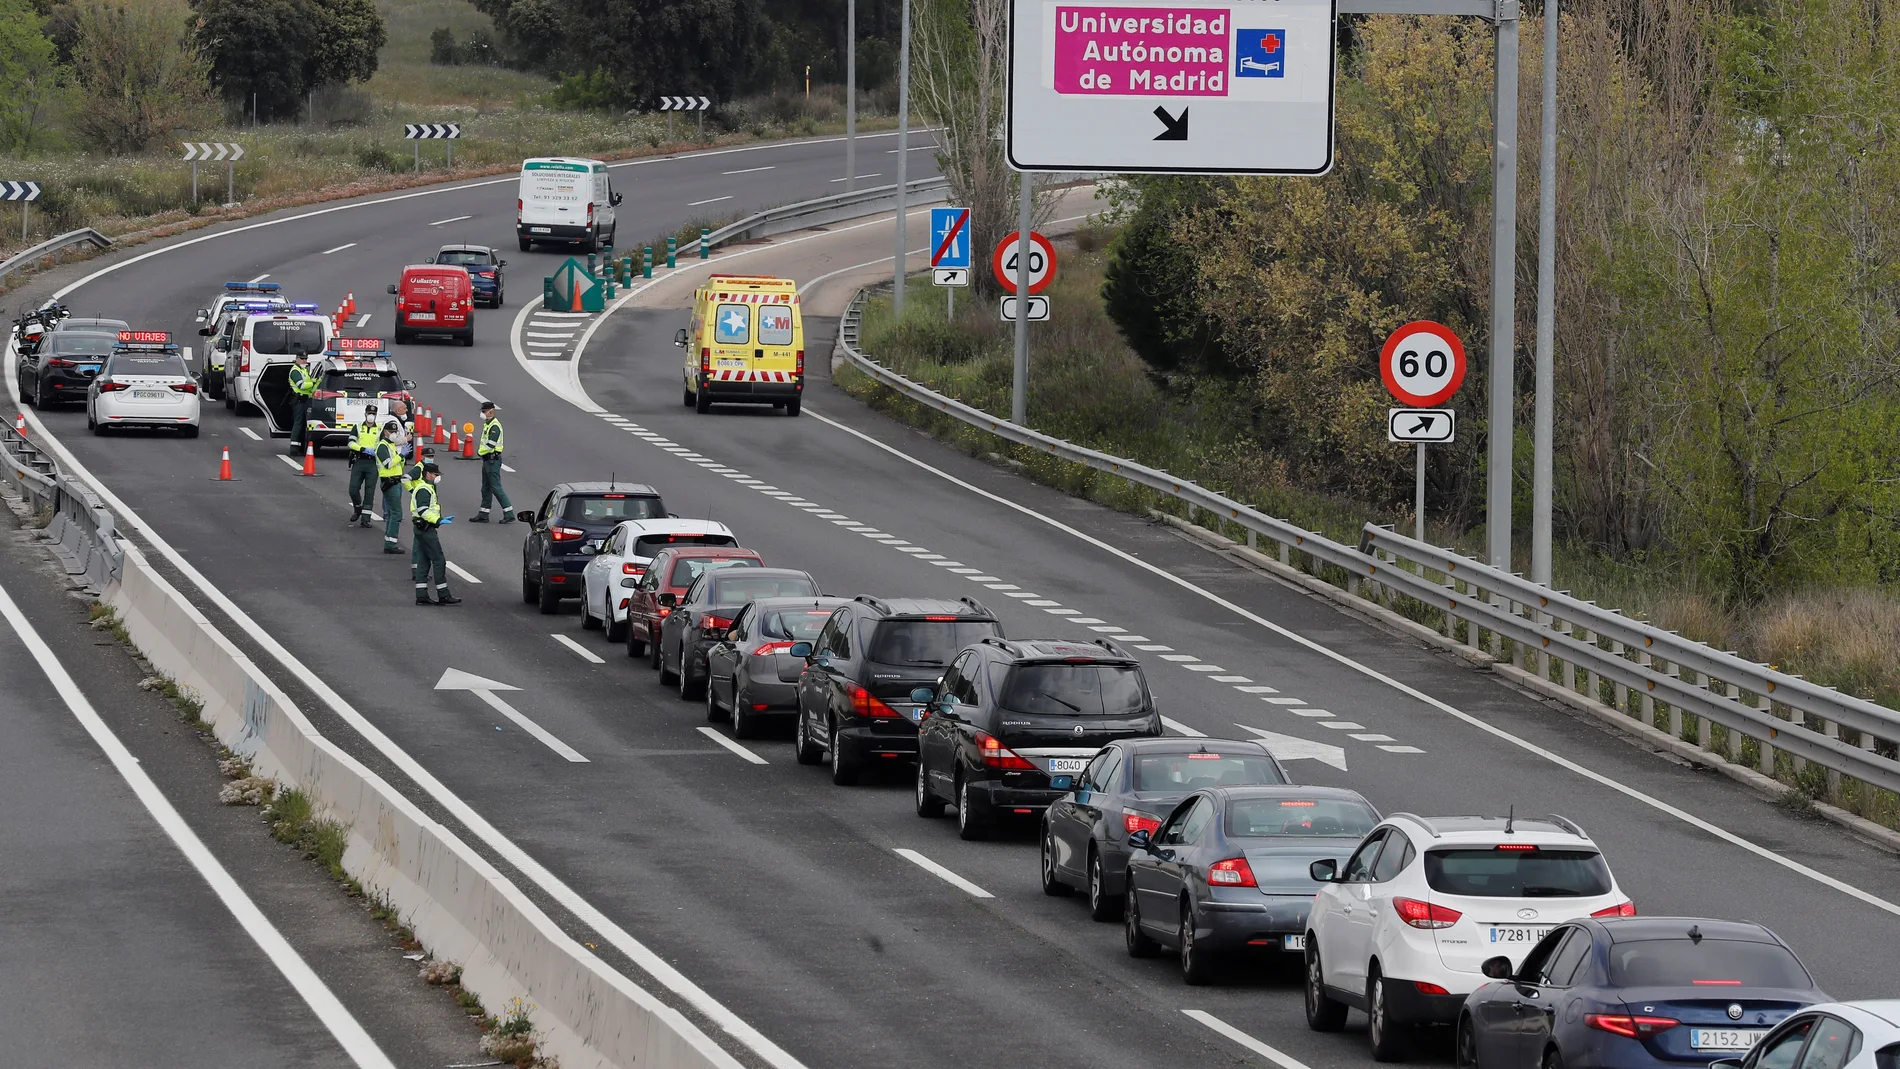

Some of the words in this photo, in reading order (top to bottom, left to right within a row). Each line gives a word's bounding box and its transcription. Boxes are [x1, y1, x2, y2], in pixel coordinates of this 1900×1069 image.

[1060, 12, 1225, 35] Universidad
[1083, 40, 1223, 63] Autónoma
[1079, 69, 1112, 89] de
[1130, 70, 1224, 91] Madrid
[1005, 252, 1044, 274] 40
[119, 332, 131, 340] NO
[134, 332, 166, 341] VIAJES
[341, 339, 353, 348] EN
[357, 340, 379, 348] CASA
[1399, 350, 1447, 378] 60
[1056, 760, 1081, 770] 8040
[1498, 929, 1531, 942] 7281
[1701, 1032, 1739, 1046] 2152
